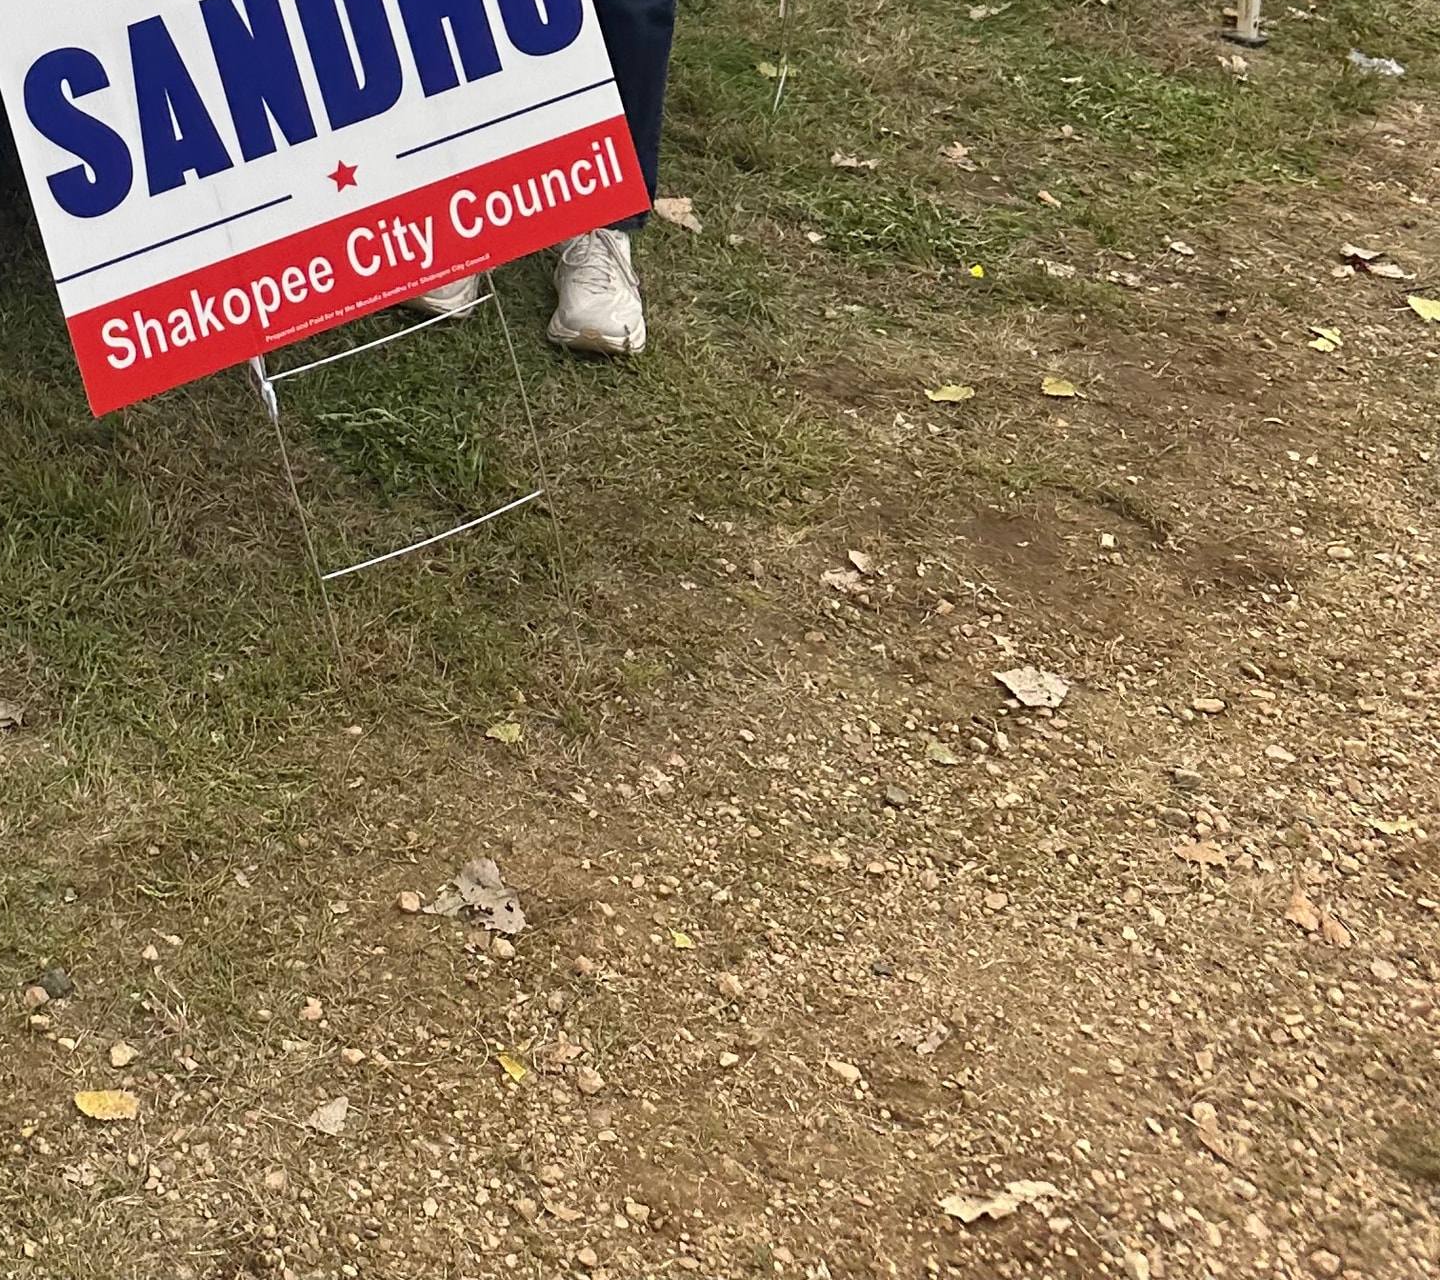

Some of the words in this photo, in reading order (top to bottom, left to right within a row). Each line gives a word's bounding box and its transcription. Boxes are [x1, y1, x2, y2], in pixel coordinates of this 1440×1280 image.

[101, 255, 336, 370] Shakopee
[346, 215, 434, 277] City
[449, 137, 624, 240] Council
